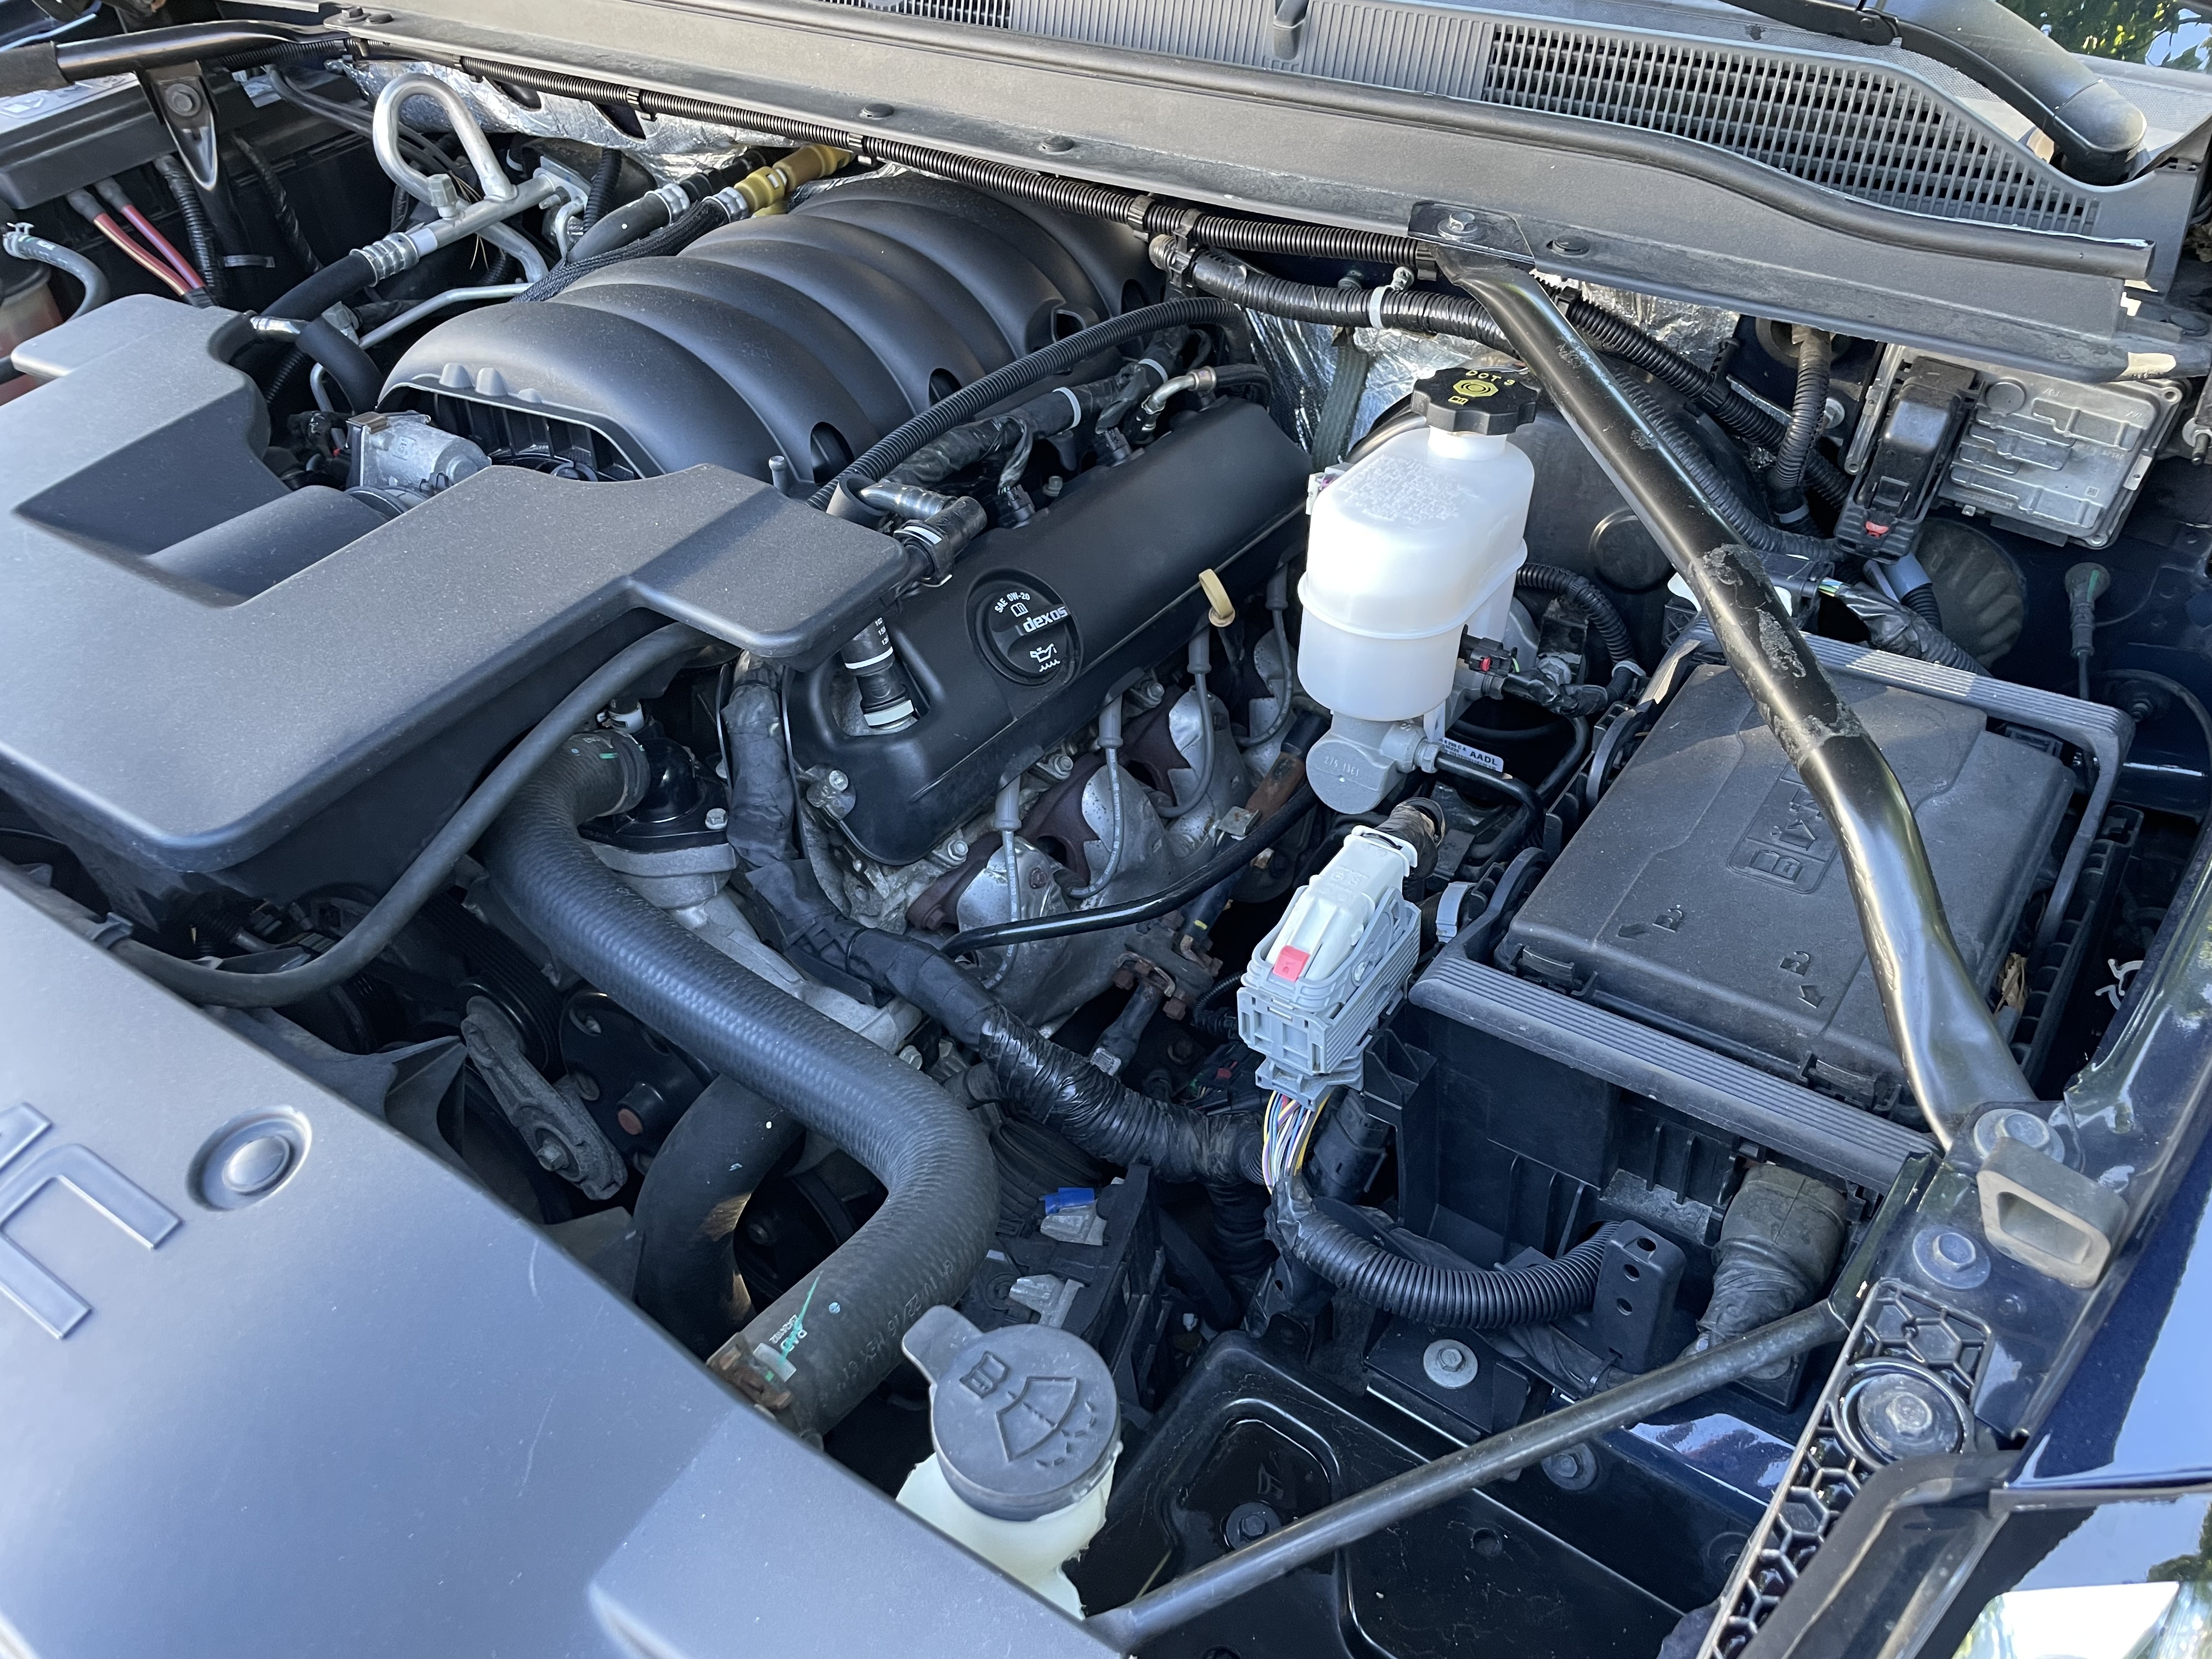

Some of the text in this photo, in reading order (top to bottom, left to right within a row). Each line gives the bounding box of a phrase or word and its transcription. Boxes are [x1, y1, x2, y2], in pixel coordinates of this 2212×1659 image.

[1465, 370, 1502, 382] DOT
[995, 592, 1030, 613] SAE 0W-20
[1023, 606, 1068, 633] dexos
[1470, 751, 1498, 766] AADL
[1008, 866, 1017, 895] 12670293
